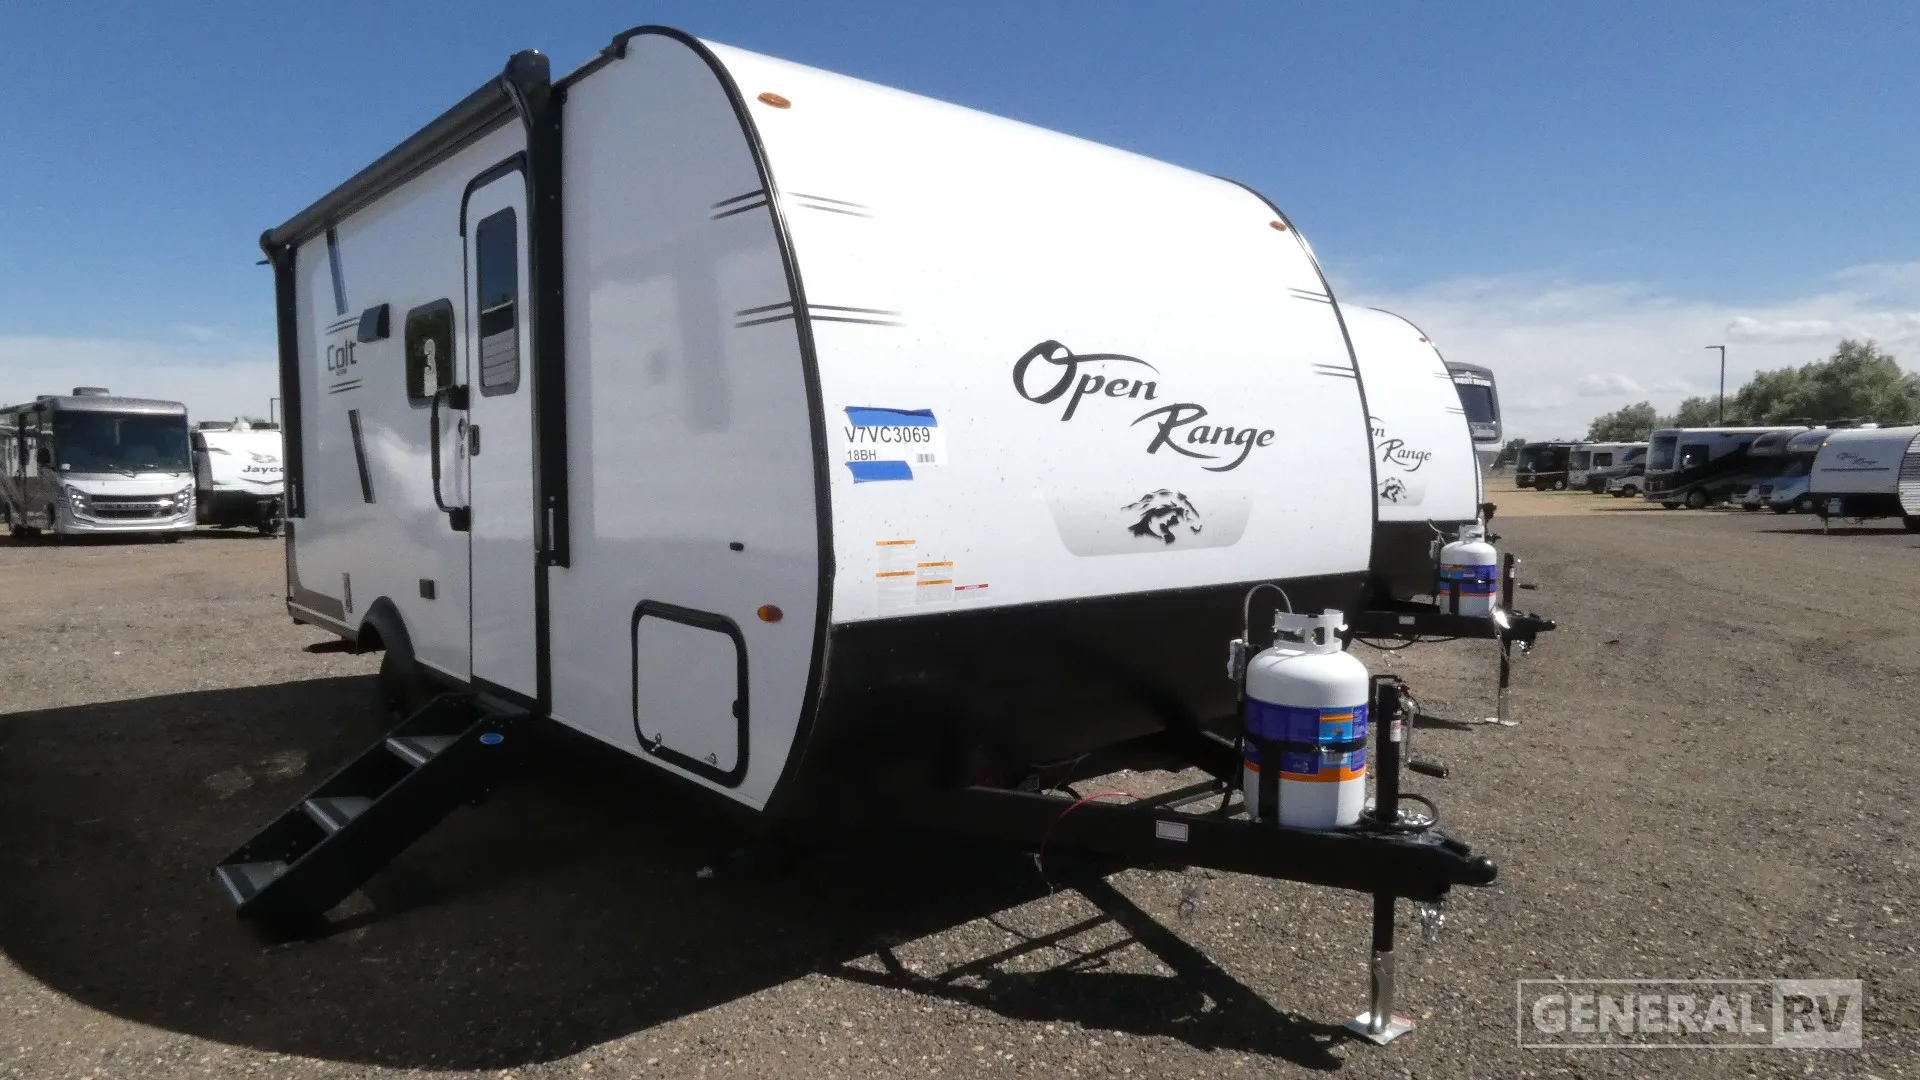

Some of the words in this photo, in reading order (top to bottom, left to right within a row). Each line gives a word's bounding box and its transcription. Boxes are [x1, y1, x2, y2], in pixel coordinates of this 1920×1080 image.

[327, 339, 358, 372] Colt
[1012, 339, 1161, 422] Open
[844, 426, 931, 443] V7VC3069
[1130, 402, 1276, 472] Range
[847, 449, 877, 461] 18BH
[1375, 438, 1432, 473] Range
